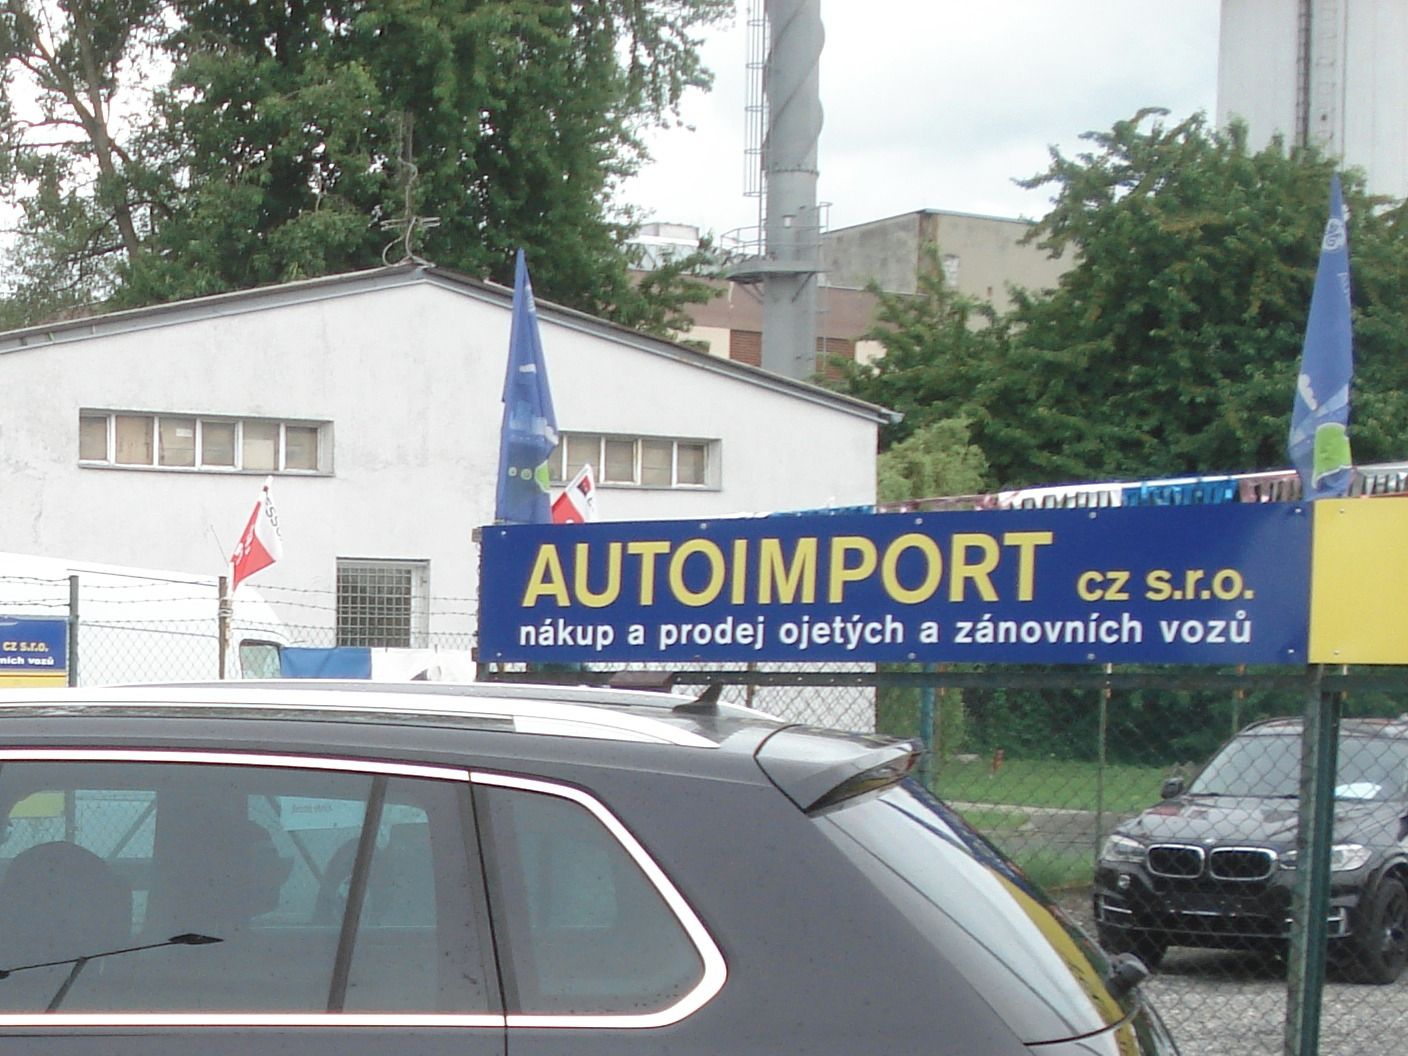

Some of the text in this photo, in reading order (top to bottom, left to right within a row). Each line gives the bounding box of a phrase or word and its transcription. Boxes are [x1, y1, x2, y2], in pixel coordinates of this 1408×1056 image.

[521, 530, 1255, 608] AUTOIMPORT cz s.r.o.
[519, 609, 1252, 651] nákup a prodej ojetých a zánovních vozů
